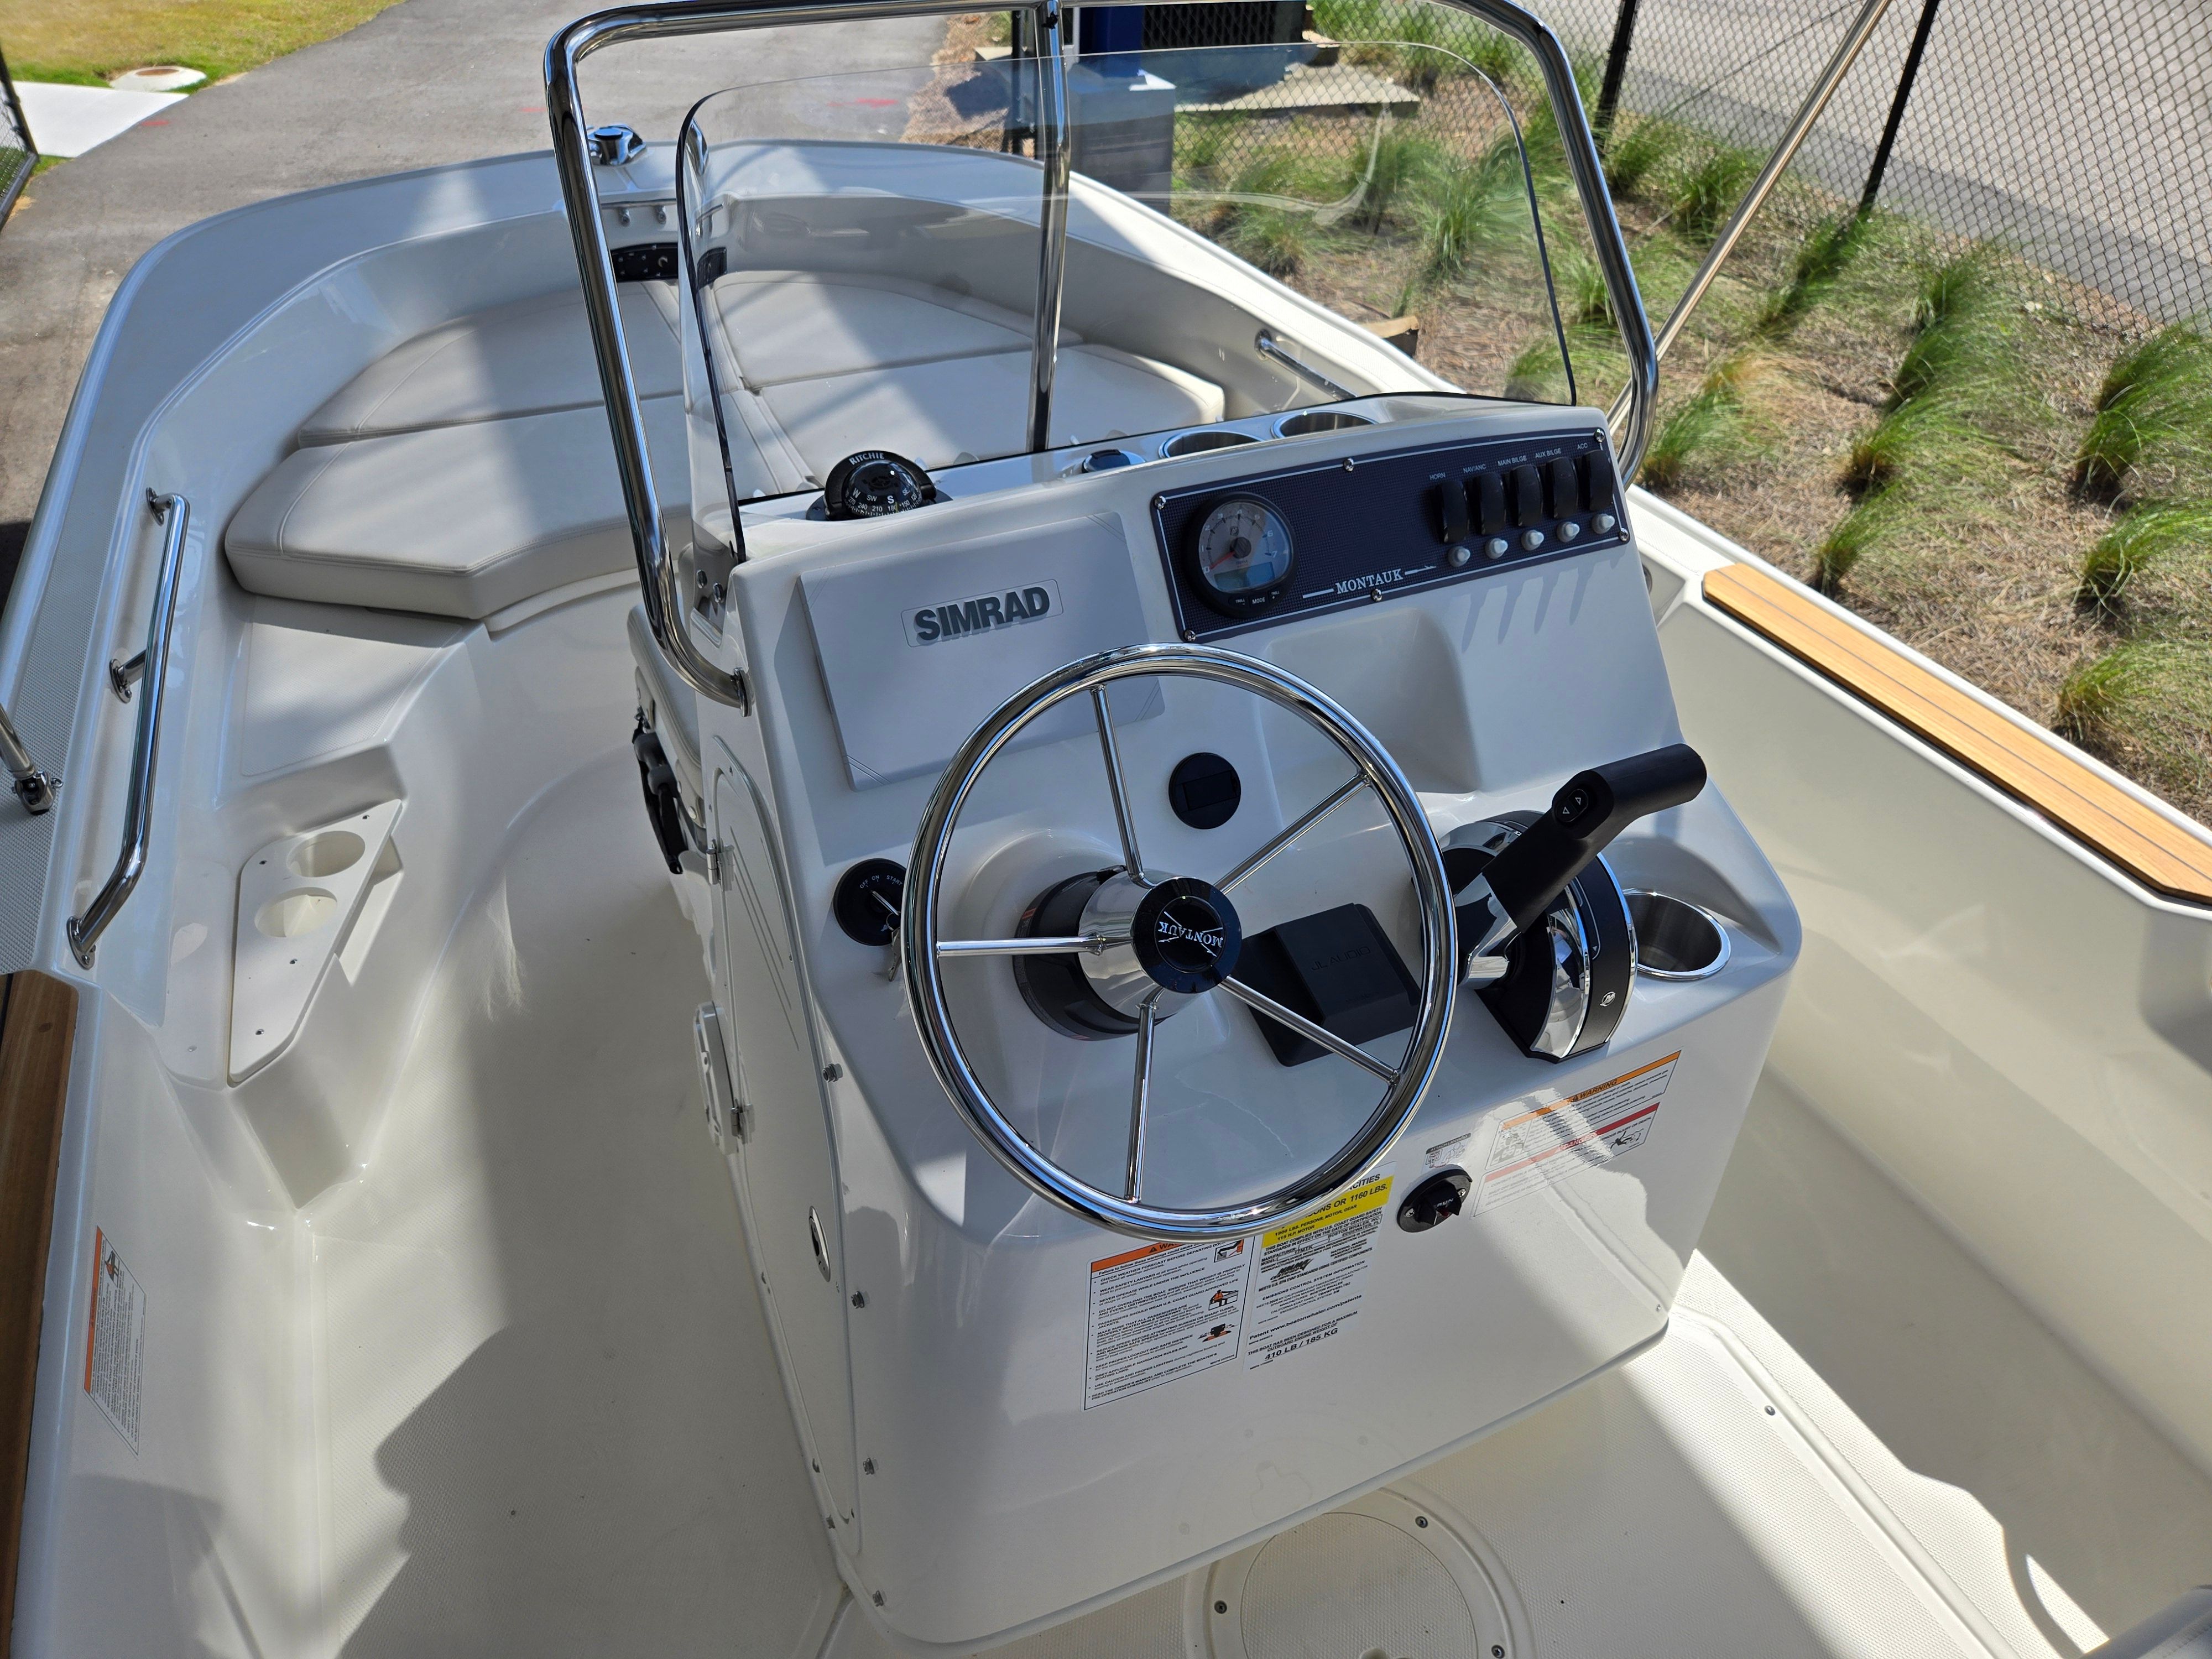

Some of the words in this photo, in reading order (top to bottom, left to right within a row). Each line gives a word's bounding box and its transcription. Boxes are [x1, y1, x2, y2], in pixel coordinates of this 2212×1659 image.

[849, 452, 885, 465] RITCHIE
[1511, 455, 1527, 463] BILGE
[1546, 448, 1562, 456] BILGE
[853, 488, 860, 498] W
[887, 495, 894, 504] S
[1335, 568, 1404, 594] MONTAUK
[915, 587, 1050, 641] SIMRAD
[859, 879, 869, 889] OFF
[886, 875, 903, 886] START
[1158, 921, 1224, 948] MONTAUK
[1330, 946, 1371, 964] AUDIO
[1580, 1079, 1618, 1098] WARNING
[1334, 1198, 1347, 1207] OR
[1350, 1191, 1368, 1202] 1160
[1369, 1183, 1387, 1195] LBS.
[1264, 1243, 1291, 1256] STANDARDS
[1297, 1235, 1314, 1244] EFFECT
[1350, 1211, 1381, 1225] CERTIFICATION
[1289, 1232, 1312, 1243] COMPLIES
[1333, 1219, 1349, 1227] COAST
[1349, 1213, 1365, 1222] GUARD
[1365, 1207, 1382, 1216] SAFETY
[1297, 1225, 1314, 1234] MOTOR
[1118, 1267, 1140, 1276] WEATHER
[1141, 1259, 1166, 1269] FORECAST
[1167, 1253, 1186, 1261] BEFORE
[1186, 1245, 1212, 1255] DEPARTING
[1116, 1288, 1137, 1297] OPERATE
[1180, 1267, 1204, 1277] INFLUENCE
[1117, 1297, 1142, 1307] OVERLOAD
[1168, 1283, 1186, 1291] ENSURE
[1222, 1264, 1245, 1274] PROPERLY
[1134, 1273, 1155, 1282] LANYARD
[1262, 1288, 1288, 1301] EMISSIONS
[1290, 1280, 1312, 1291] CONTROL
[1313, 1272, 1333, 1282] SYSTEM
[1333, 1260, 1365, 1275] INFORMATION
[1098, 1314, 1128, 1326] PASSENGERS
[1205, 1282, 1229, 1291] APPROVED
[1128, 1295, 1157, 1307] DISTRIBUTED
[1147, 1308, 1177, 1319] PASSENGERS
[1249, 1330, 1269, 1340] Patent
[1267, 1339, 1293, 1352] OUTBOARD
[1294, 1332, 1312, 1342] ENGINE
[1312, 1324, 1331, 1334] WEIGHT
[1297, 1325, 1321, 1337] DESIGNED
[1265, 1349, 1282, 1359] 410
[1284, 1344, 1297, 1353] LB
[1306, 1334, 1321, 1344] 185
[1323, 1328, 1338, 1338] KG
